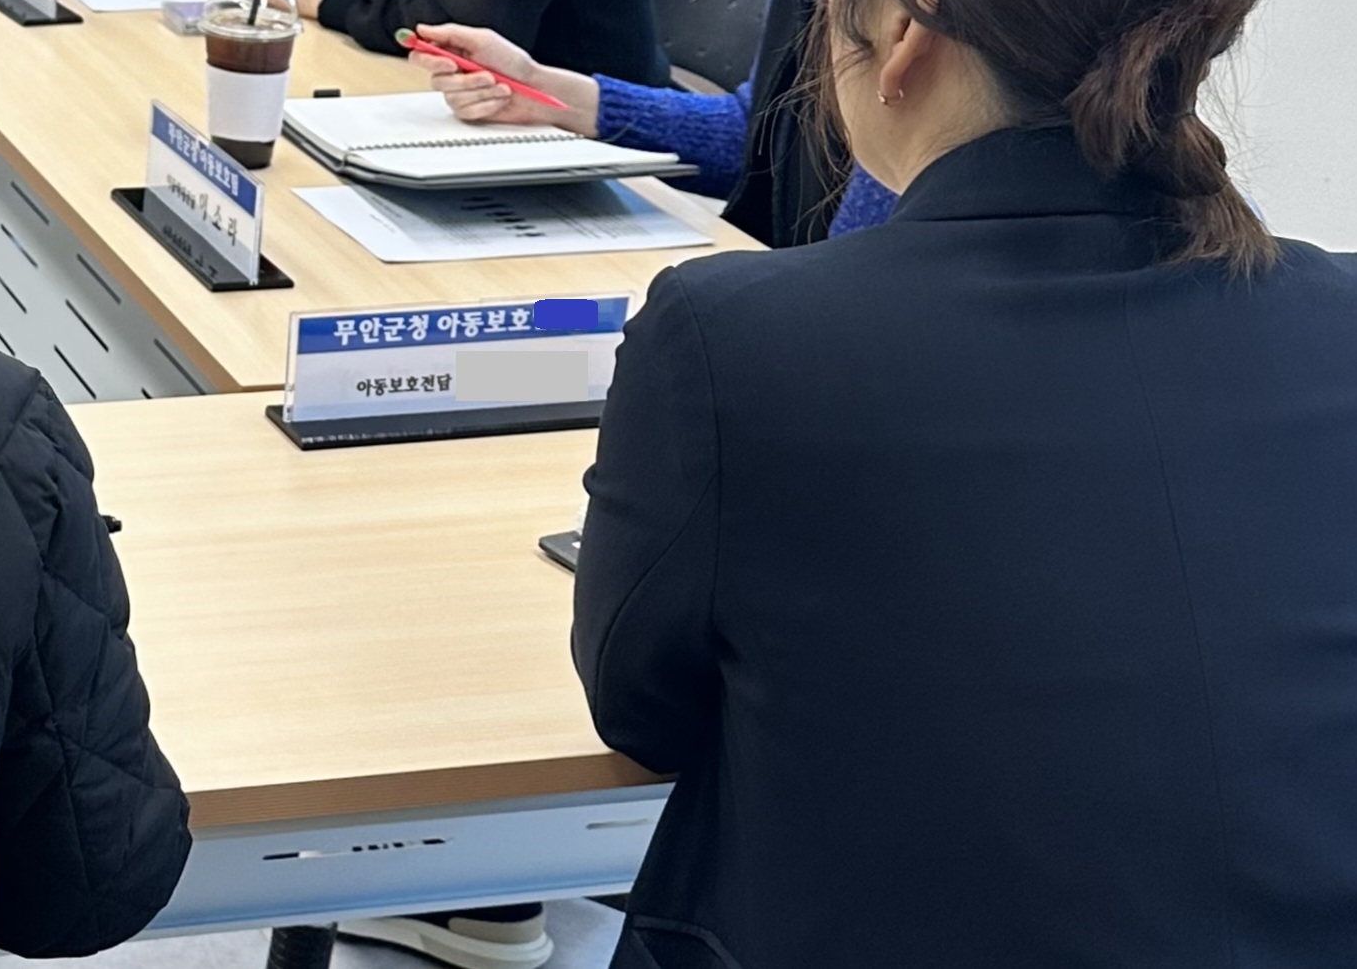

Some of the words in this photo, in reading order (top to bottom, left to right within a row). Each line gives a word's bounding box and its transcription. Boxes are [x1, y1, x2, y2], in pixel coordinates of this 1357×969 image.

[167, 121, 202, 164] 무안군청
[199, 149, 239, 197] 아동보호팀
[333, 313, 429, 346] 무안군청
[436, 307, 539, 338] 아동보호
[355, 373, 453, 398] 아동보호전담
